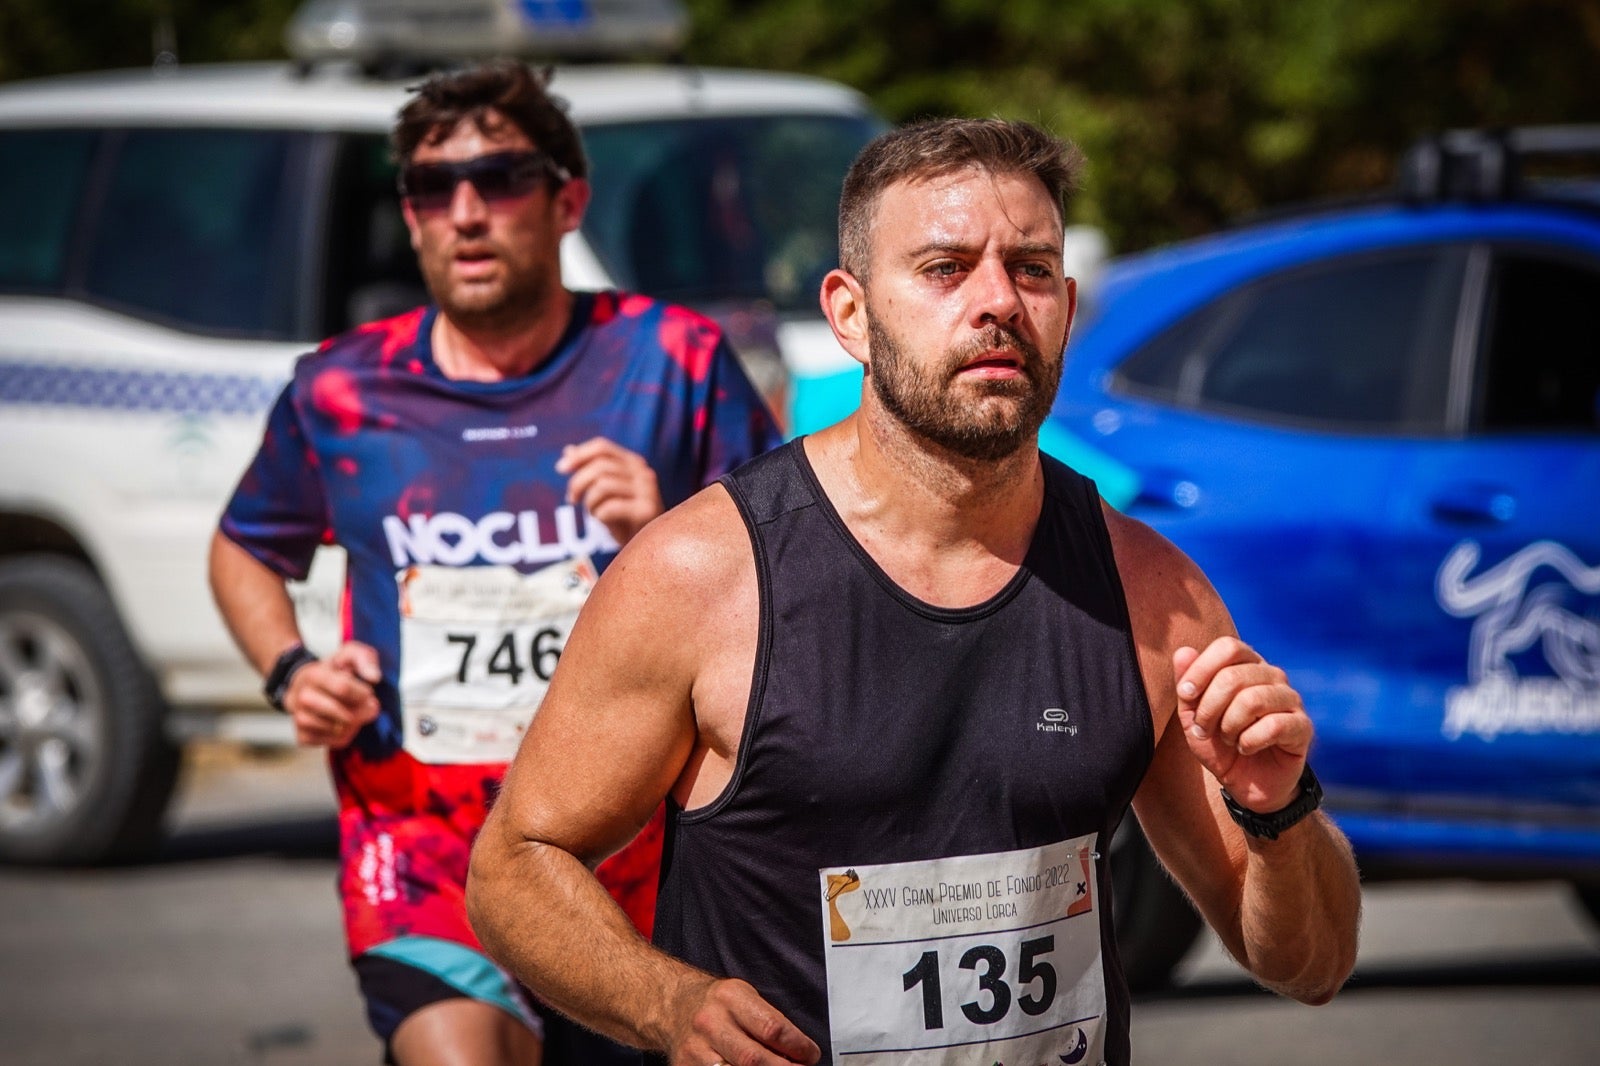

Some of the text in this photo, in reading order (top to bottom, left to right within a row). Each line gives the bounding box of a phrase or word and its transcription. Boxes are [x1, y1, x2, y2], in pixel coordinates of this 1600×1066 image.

[382, 506, 620, 566] NOCLU
[446, 627, 562, 685] 746
[1036, 722, 1078, 736] Kalenji
[863, 886, 897, 910] XXXV
[1045, 864, 1070, 889] 2022
[902, 934, 1058, 1031] 135
